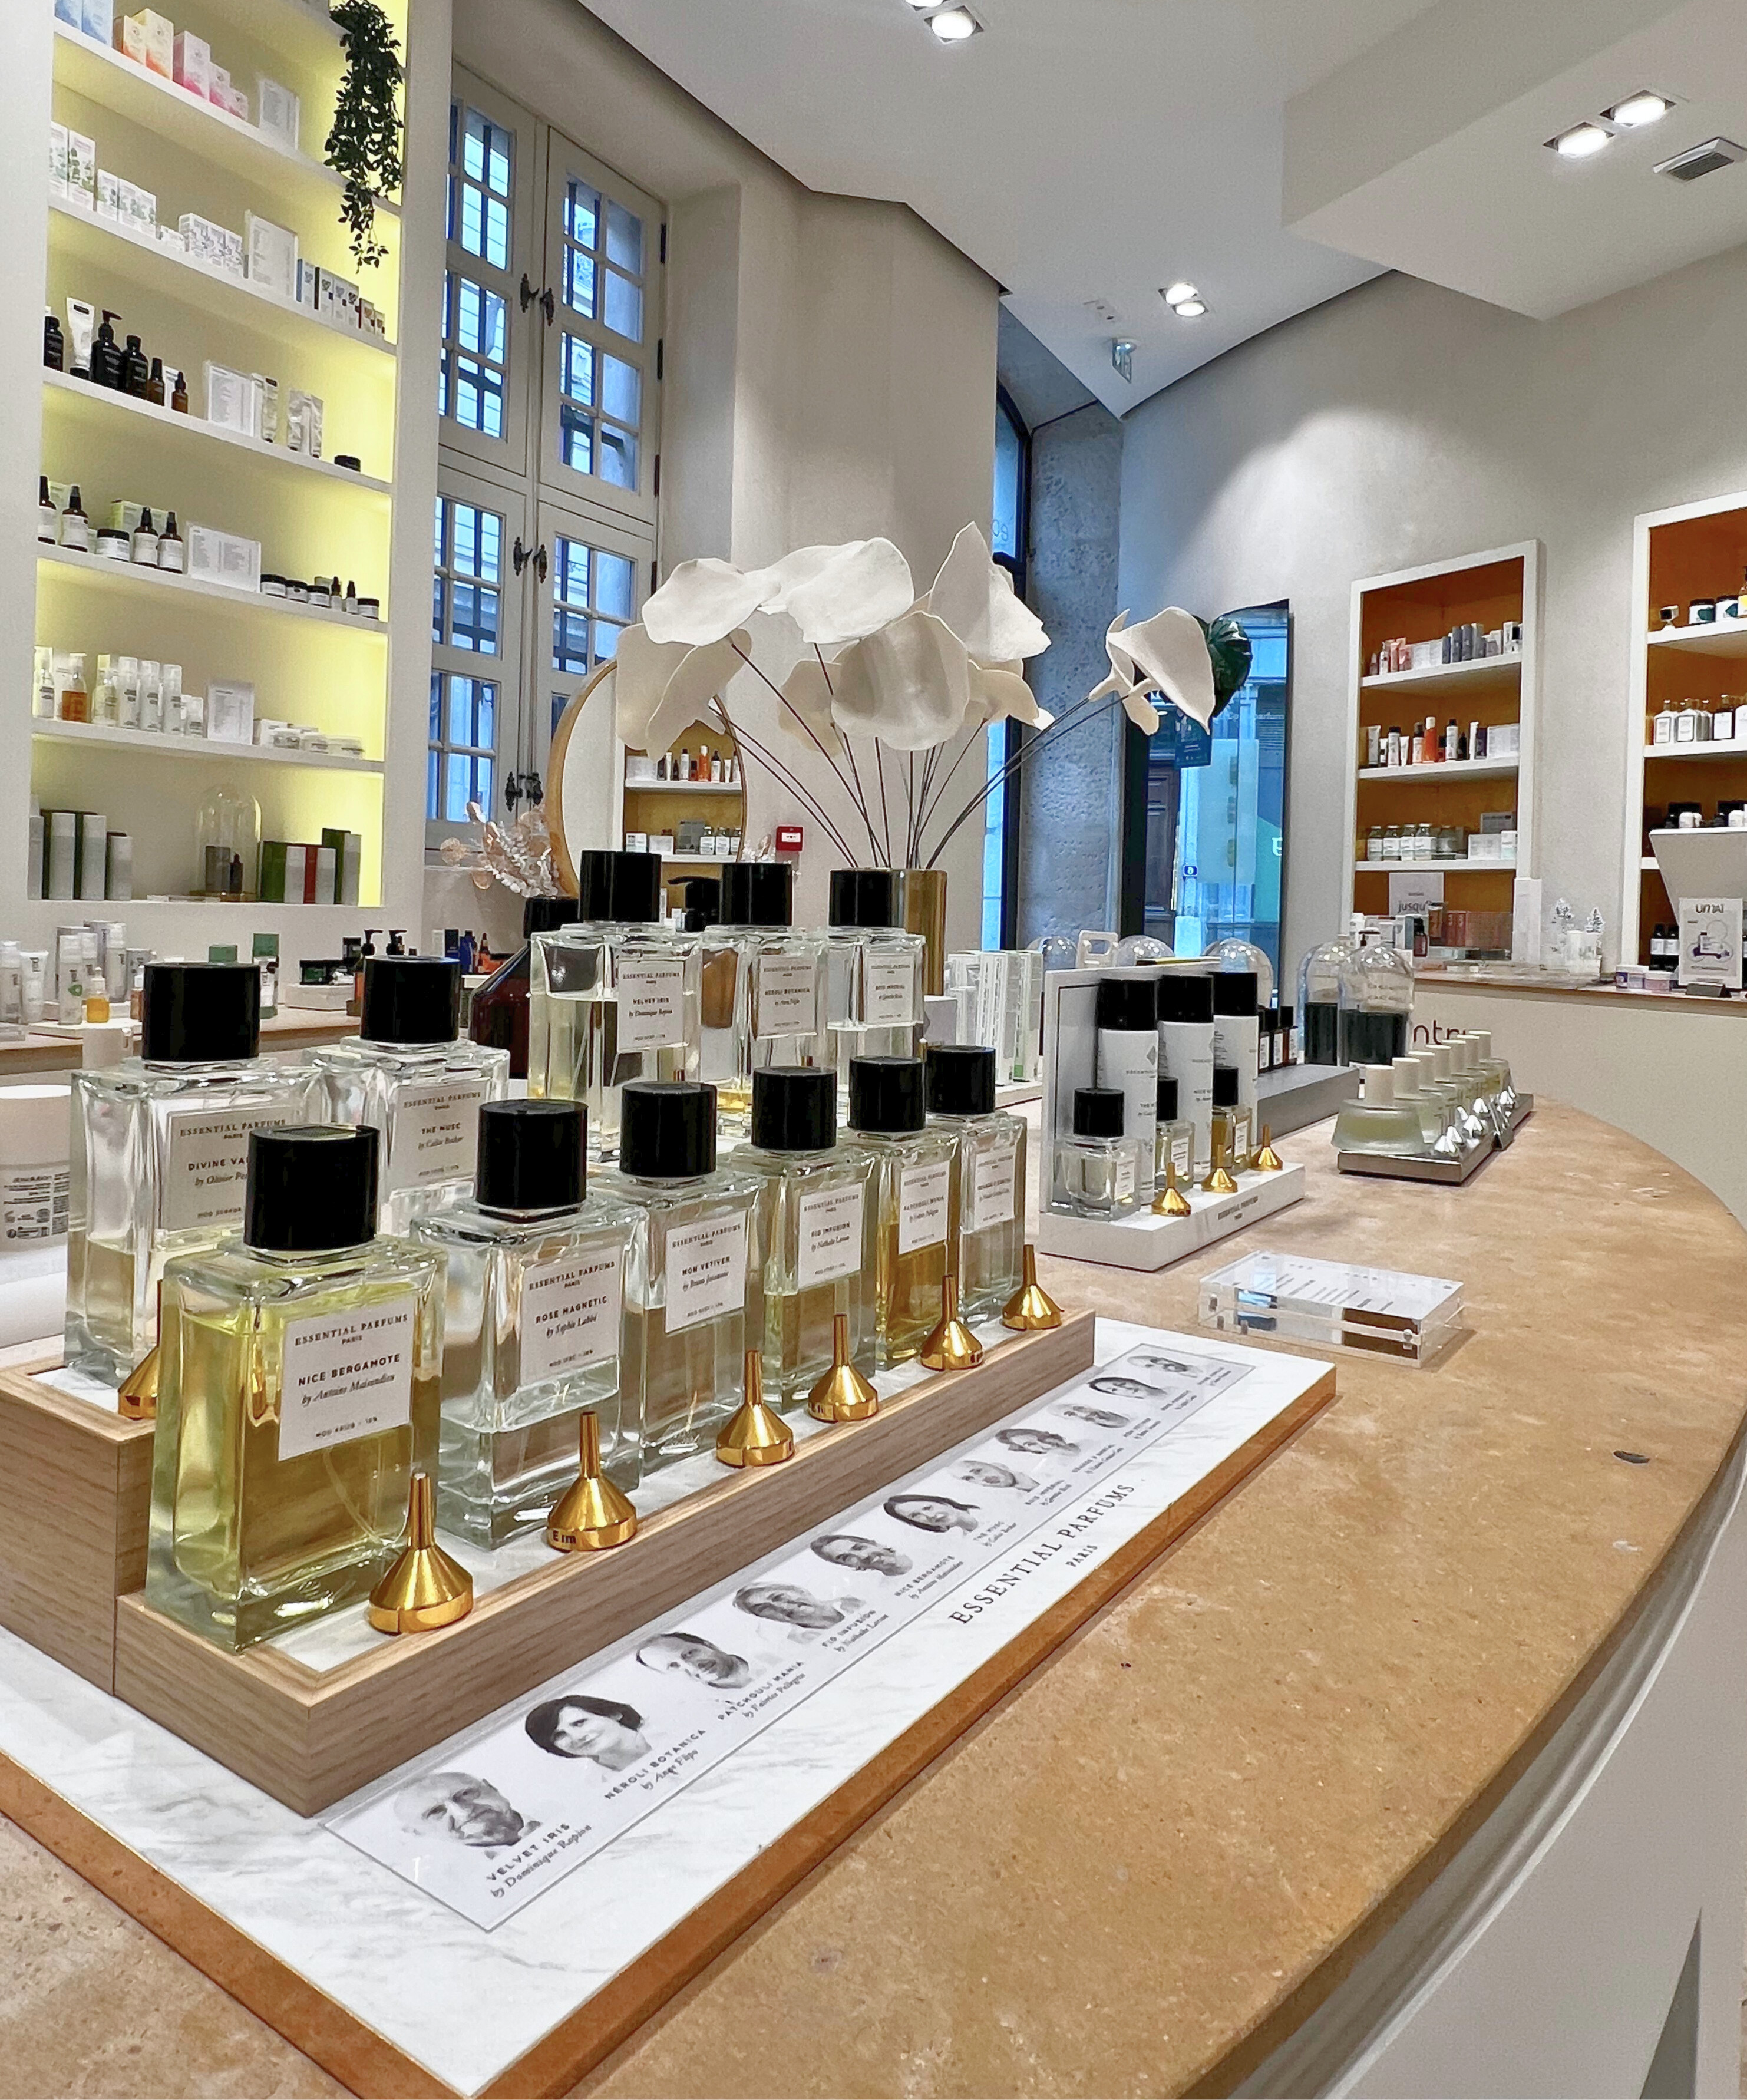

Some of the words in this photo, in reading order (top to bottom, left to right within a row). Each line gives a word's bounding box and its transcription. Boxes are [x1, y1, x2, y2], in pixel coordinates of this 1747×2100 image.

[180, 1125, 237, 1137] ESSENTIAL
[188, 1159, 226, 1171] DIVINE
[230, 1157, 249, 1165] VA
[529, 1272, 575, 1290] ESSENTIAL
[579, 1261, 615, 1277] PARFUMS
[536, 1310, 559, 1324] ROSE
[562, 1296, 607, 1315] MAGNETIC
[295, 1326, 356, 1346] ESSENTIAL
[361, 1314, 408, 1331] PARFUMS
[342, 1335, 362, 1345] PARIS
[298, 1372, 326, 1386] NICE
[331, 1353, 400, 1379] BERGAMOTE
[302, 1394, 312, 1408] by
[948, 1543, 1063, 1624] ESSENTIAL
[1056, 1485, 1135, 1538] PARFUMS
[1066, 1544, 1098, 1567] PARIS
[605, 1768, 649, 1799] NEROLI
[649, 1729, 706, 1768] BOTANICA
[486, 1844, 539, 1881] VELVET
[543, 1824, 569, 1843] IRIS
[490, 1887, 505, 1897] by
